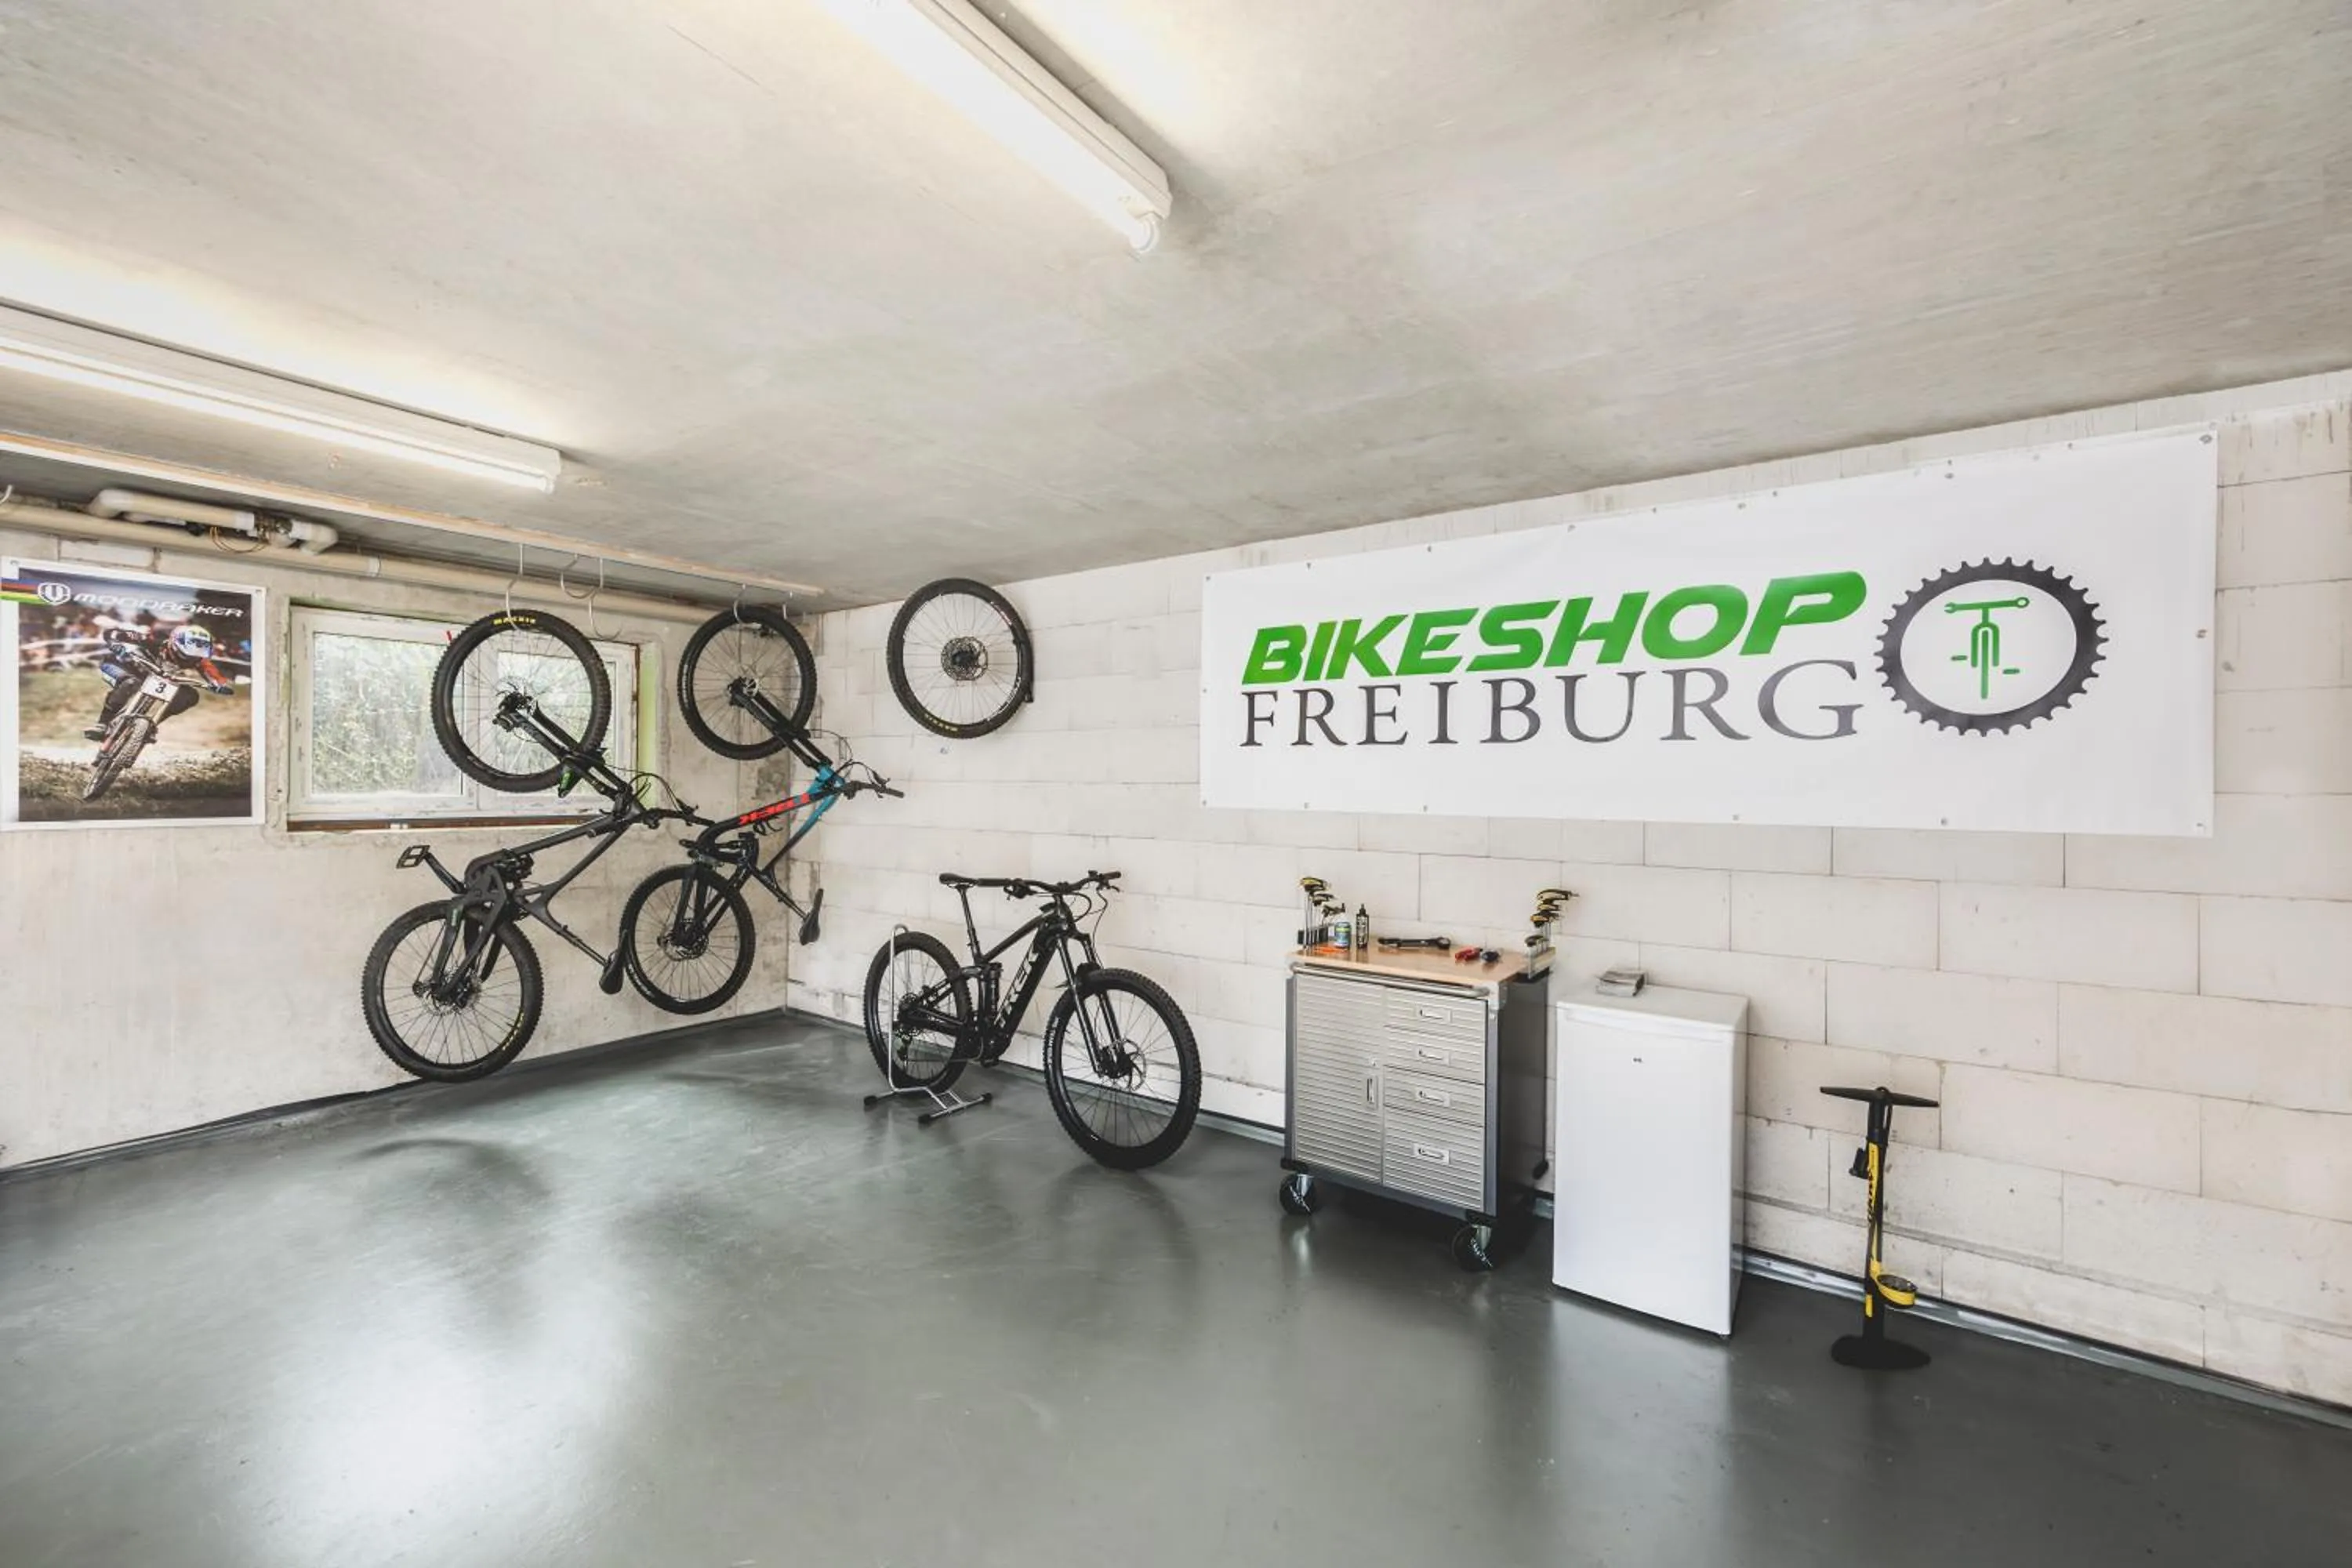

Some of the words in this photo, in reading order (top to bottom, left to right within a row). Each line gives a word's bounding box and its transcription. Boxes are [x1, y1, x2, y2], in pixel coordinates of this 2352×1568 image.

[1241, 571, 1867, 685] BIKESHOP
[154, 682, 167, 694] 3
[1240, 659, 1864, 748] FREIBURG
[993, 943, 1040, 1029] TREK
